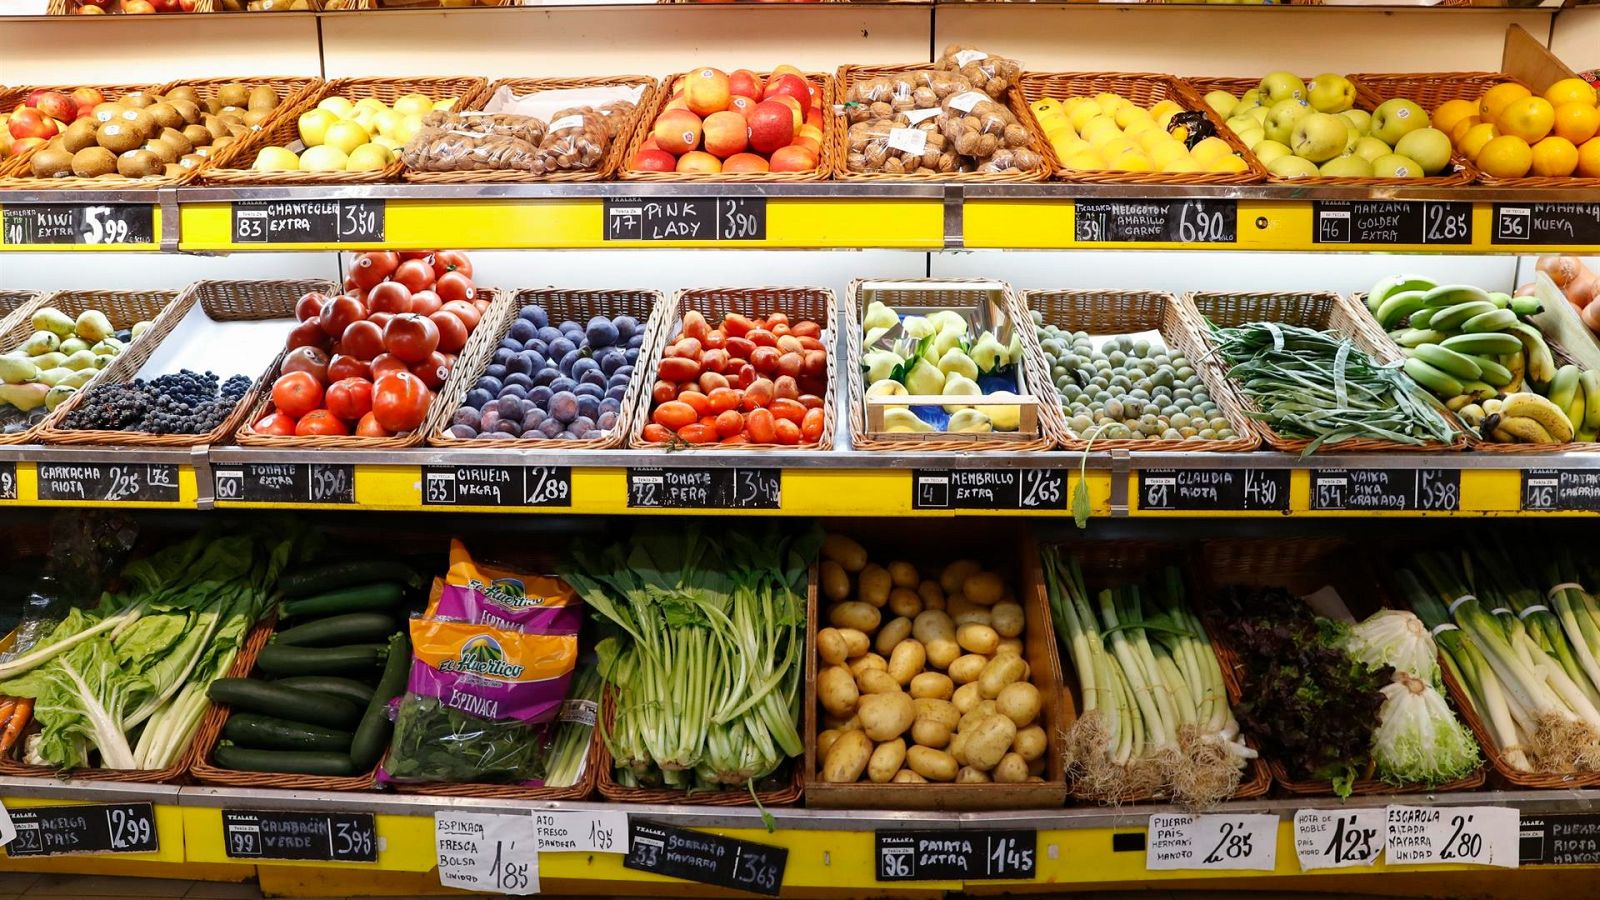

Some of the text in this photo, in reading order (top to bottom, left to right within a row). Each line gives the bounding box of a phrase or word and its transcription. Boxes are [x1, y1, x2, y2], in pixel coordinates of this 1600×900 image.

[1354, 203, 1410, 214] MANZANA
[270, 218, 310, 231] EXTRA
[612, 214, 637, 234] 17
[1118, 215, 1165, 225] AMARILLO
[1358, 215, 1400, 229] GOLDEN
[1502, 217, 1522, 234] 36
[38, 227, 74, 238] EXTRA
[239, 218, 262, 237] 83
[653, 222, 700, 239] LADY
[1082, 220, 1099, 240] 39
[1322, 220, 1339, 238] 46
[1361, 231, 1398, 242] EXTRA
[153, 469, 169, 484] 76
[260, 476, 293, 485] EXTRA
[457, 468, 510, 482] CIRUELA
[952, 472, 1013, 485] MEMBRILLO
[1178, 472, 1232, 484] CLAUDIA
[218, 478, 236, 496] 60
[459, 484, 500, 504] NEGRA
[633, 483, 658, 505] 72
[923, 484, 933, 502] 4
[670, 487, 707, 504] PERA
[956, 488, 993, 502] EXTRA
[1148, 485, 1168, 507] 61
[1320, 485, 1341, 507] 54
[1530, 487, 1553, 506] 16
[456, 653, 524, 678] Huertico
[449, 689, 498, 719] ESPINACA
[536, 816, 554, 826] AJO
[1154, 817, 1193, 828] PUERRO
[1322, 815, 1332, 823] DE
[537, 828, 568, 836] FRESCO
[1300, 824, 1326, 833] ROBLE
[235, 833, 253, 852] 99
[265, 837, 311, 848] VERDE
[440, 840, 478, 854] FRESCA
[1554, 840, 1596, 851] RIOJA
[439, 855, 475, 867] BOLSA
[666, 853, 716, 872] NAVARRA
[885, 854, 909, 876] 96
